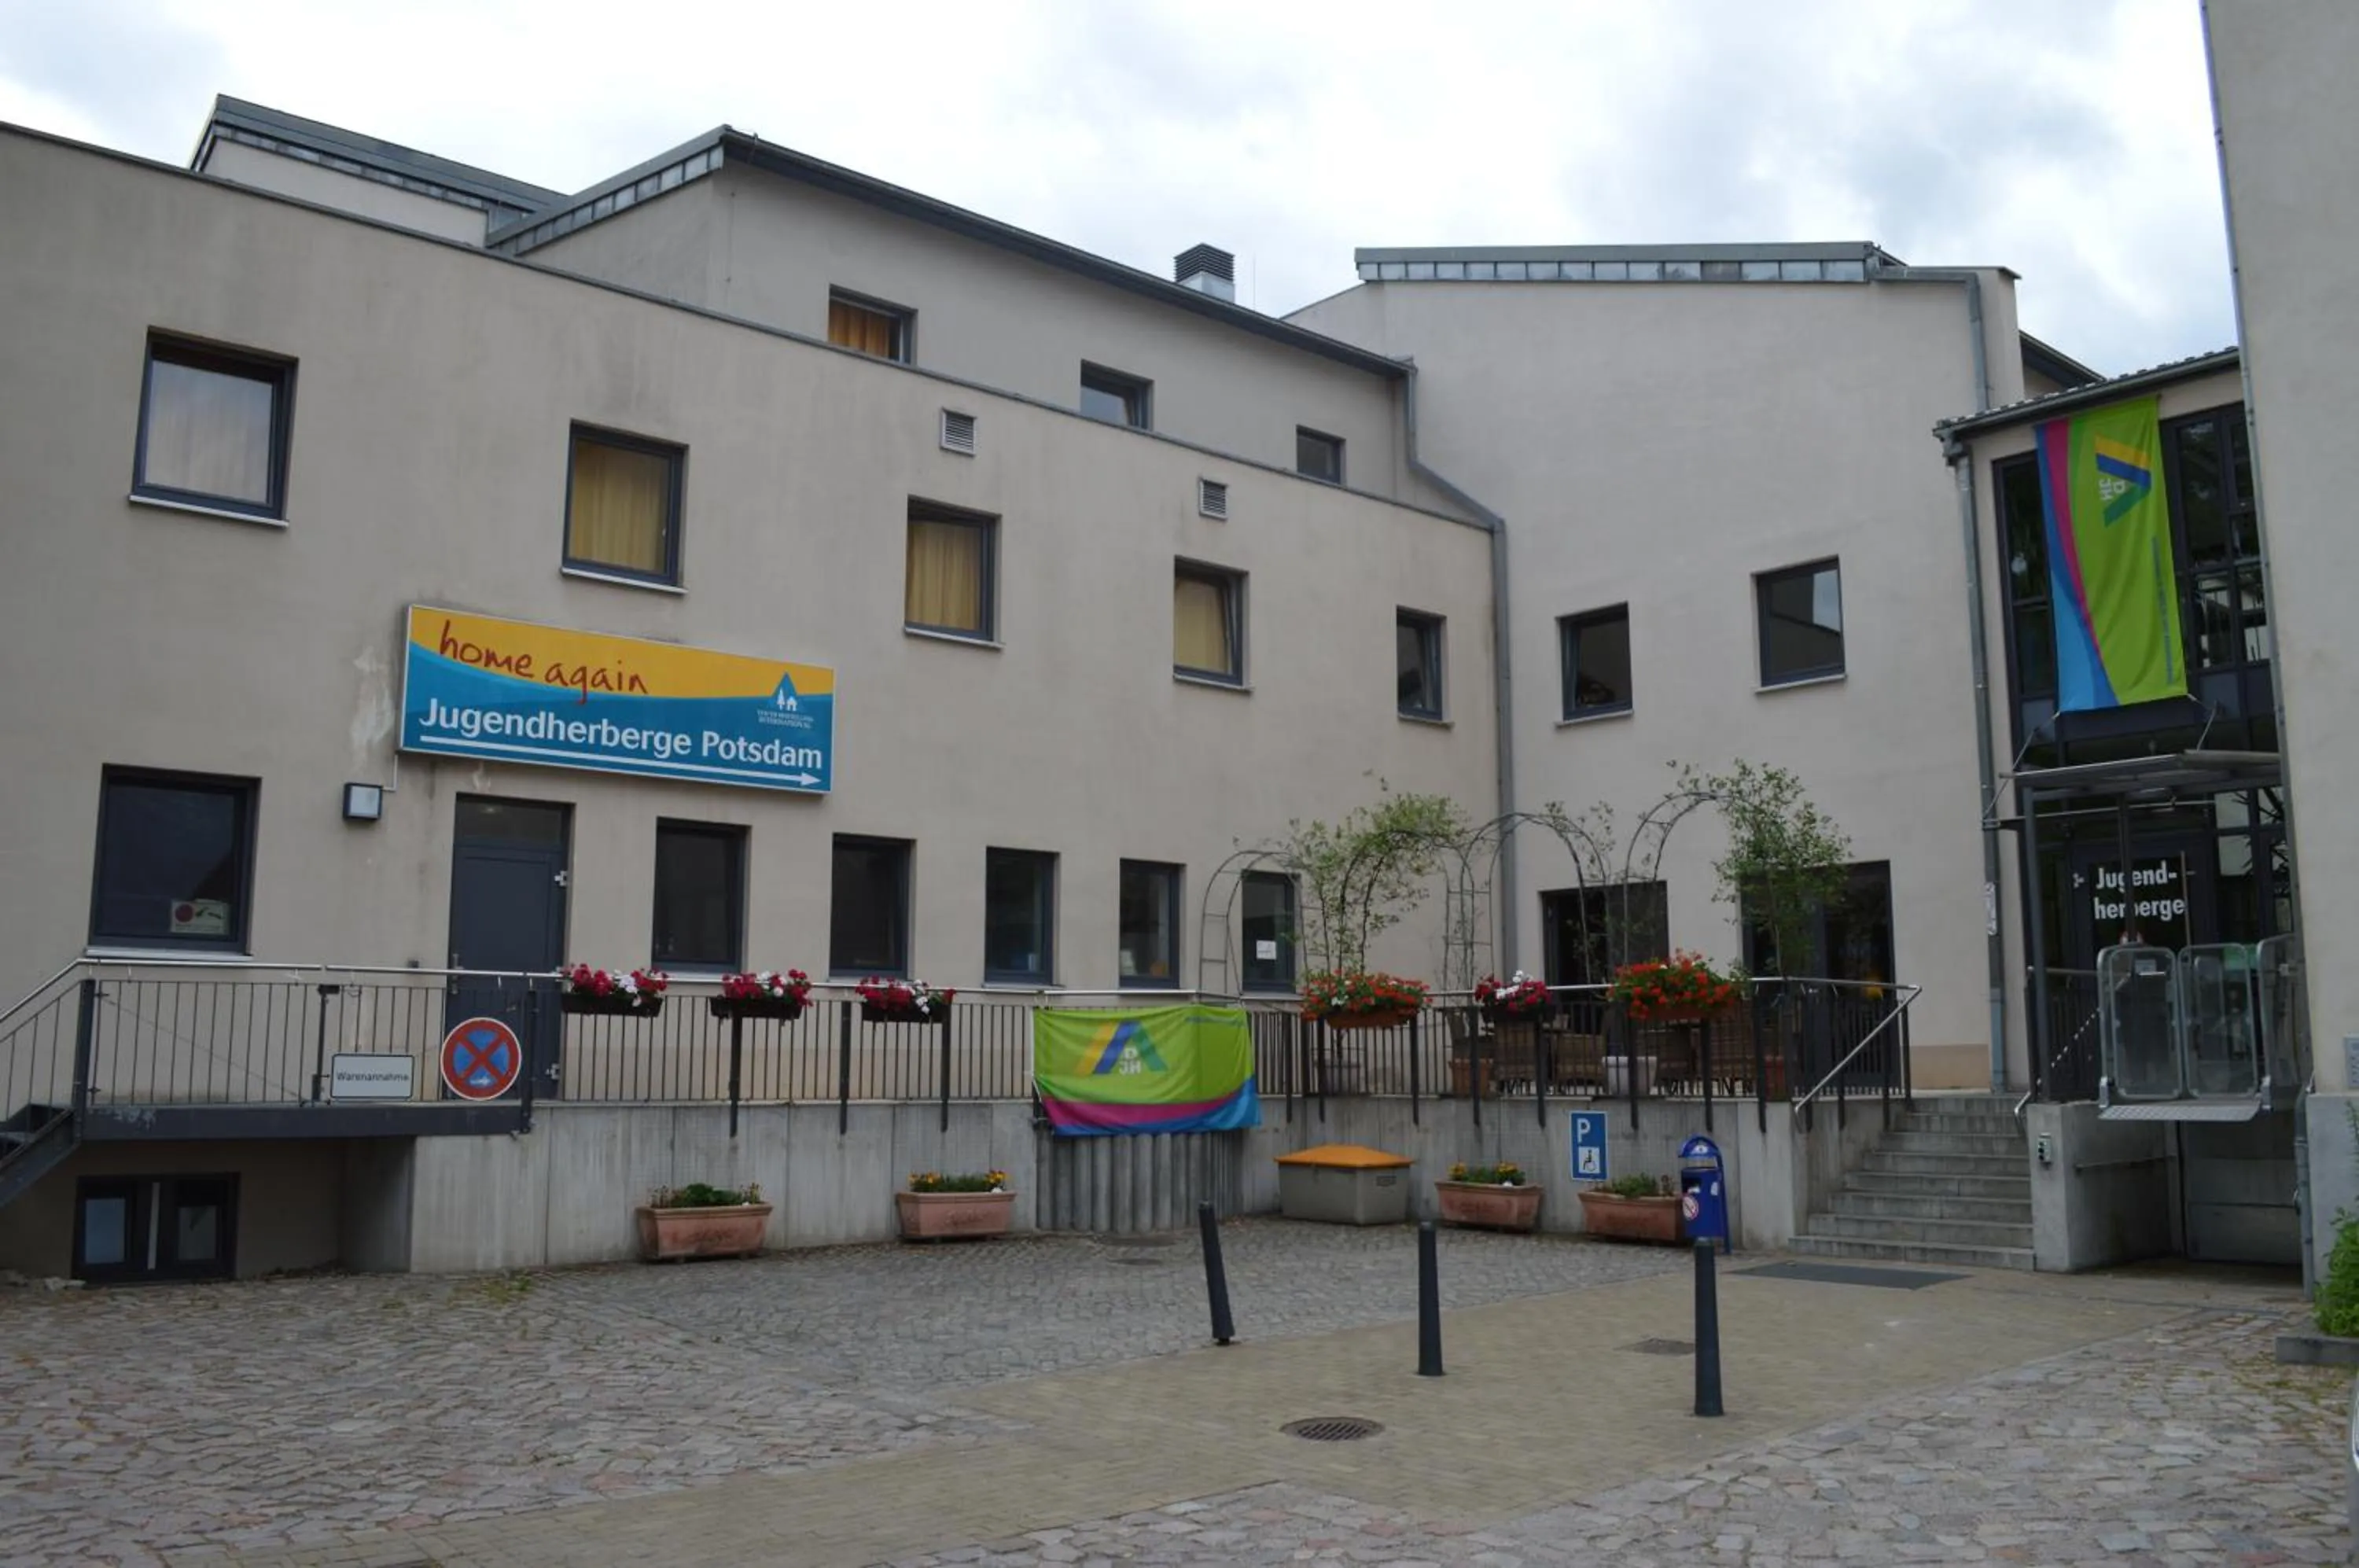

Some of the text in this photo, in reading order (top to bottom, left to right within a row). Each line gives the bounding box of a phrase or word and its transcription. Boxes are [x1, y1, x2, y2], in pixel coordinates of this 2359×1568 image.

[440, 620, 648, 704] home again
[418, 698, 823, 769] Jugendherberge Potsdam
[2093, 896, 2186, 922] hererge
[337, 1071, 410, 1082] Warenannahme
[1577, 1117, 1591, 1143] P
